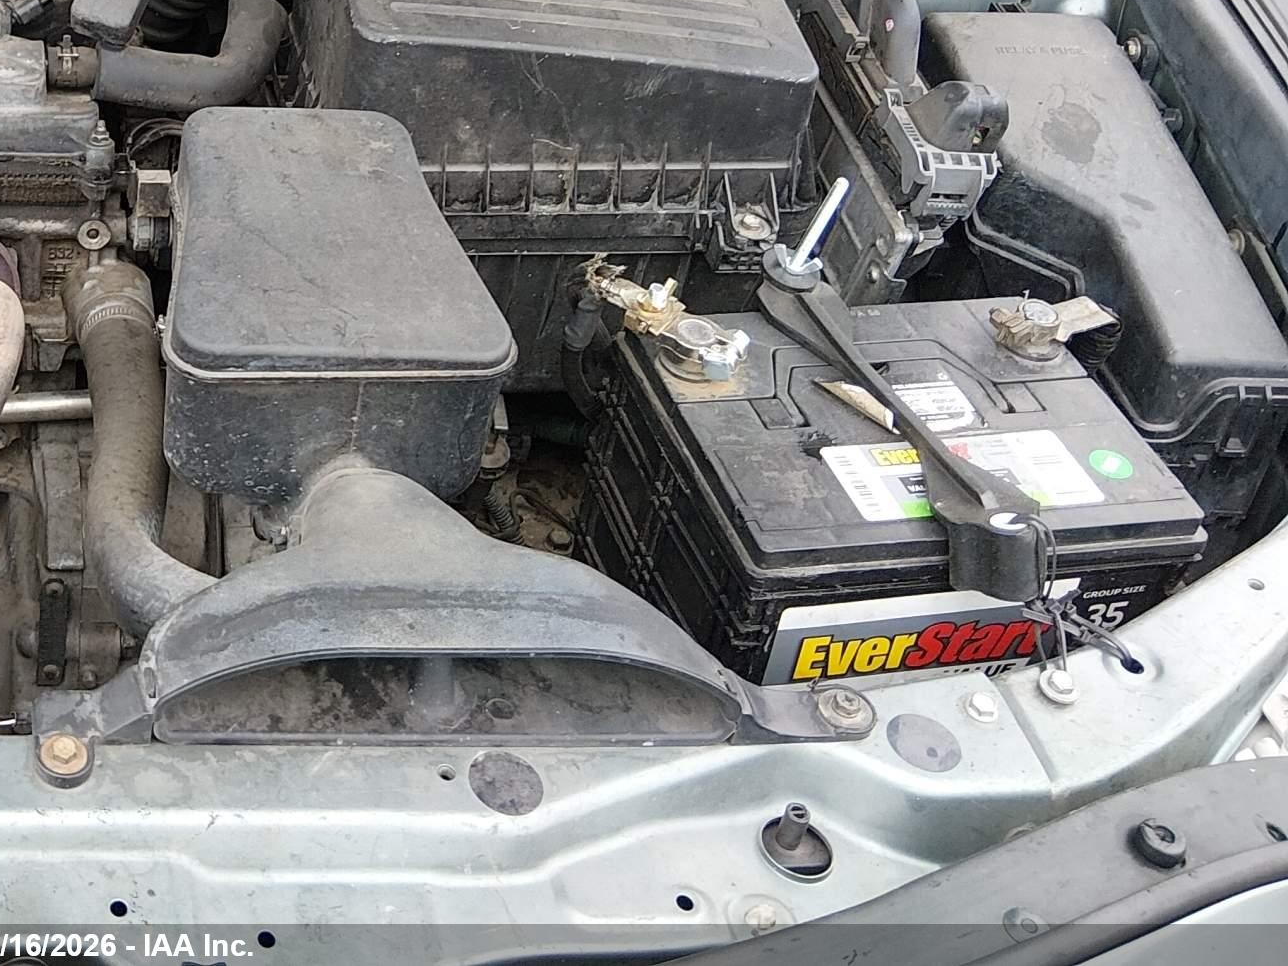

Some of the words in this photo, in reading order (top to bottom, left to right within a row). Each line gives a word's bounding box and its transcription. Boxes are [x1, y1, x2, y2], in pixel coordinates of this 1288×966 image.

[1083, 587, 1122, 599] GROUP
[1123, 584, 1147, 594] SIZE
[1086, 601, 1129, 632] 35
[791, 620, 1051, 681] EverStart
